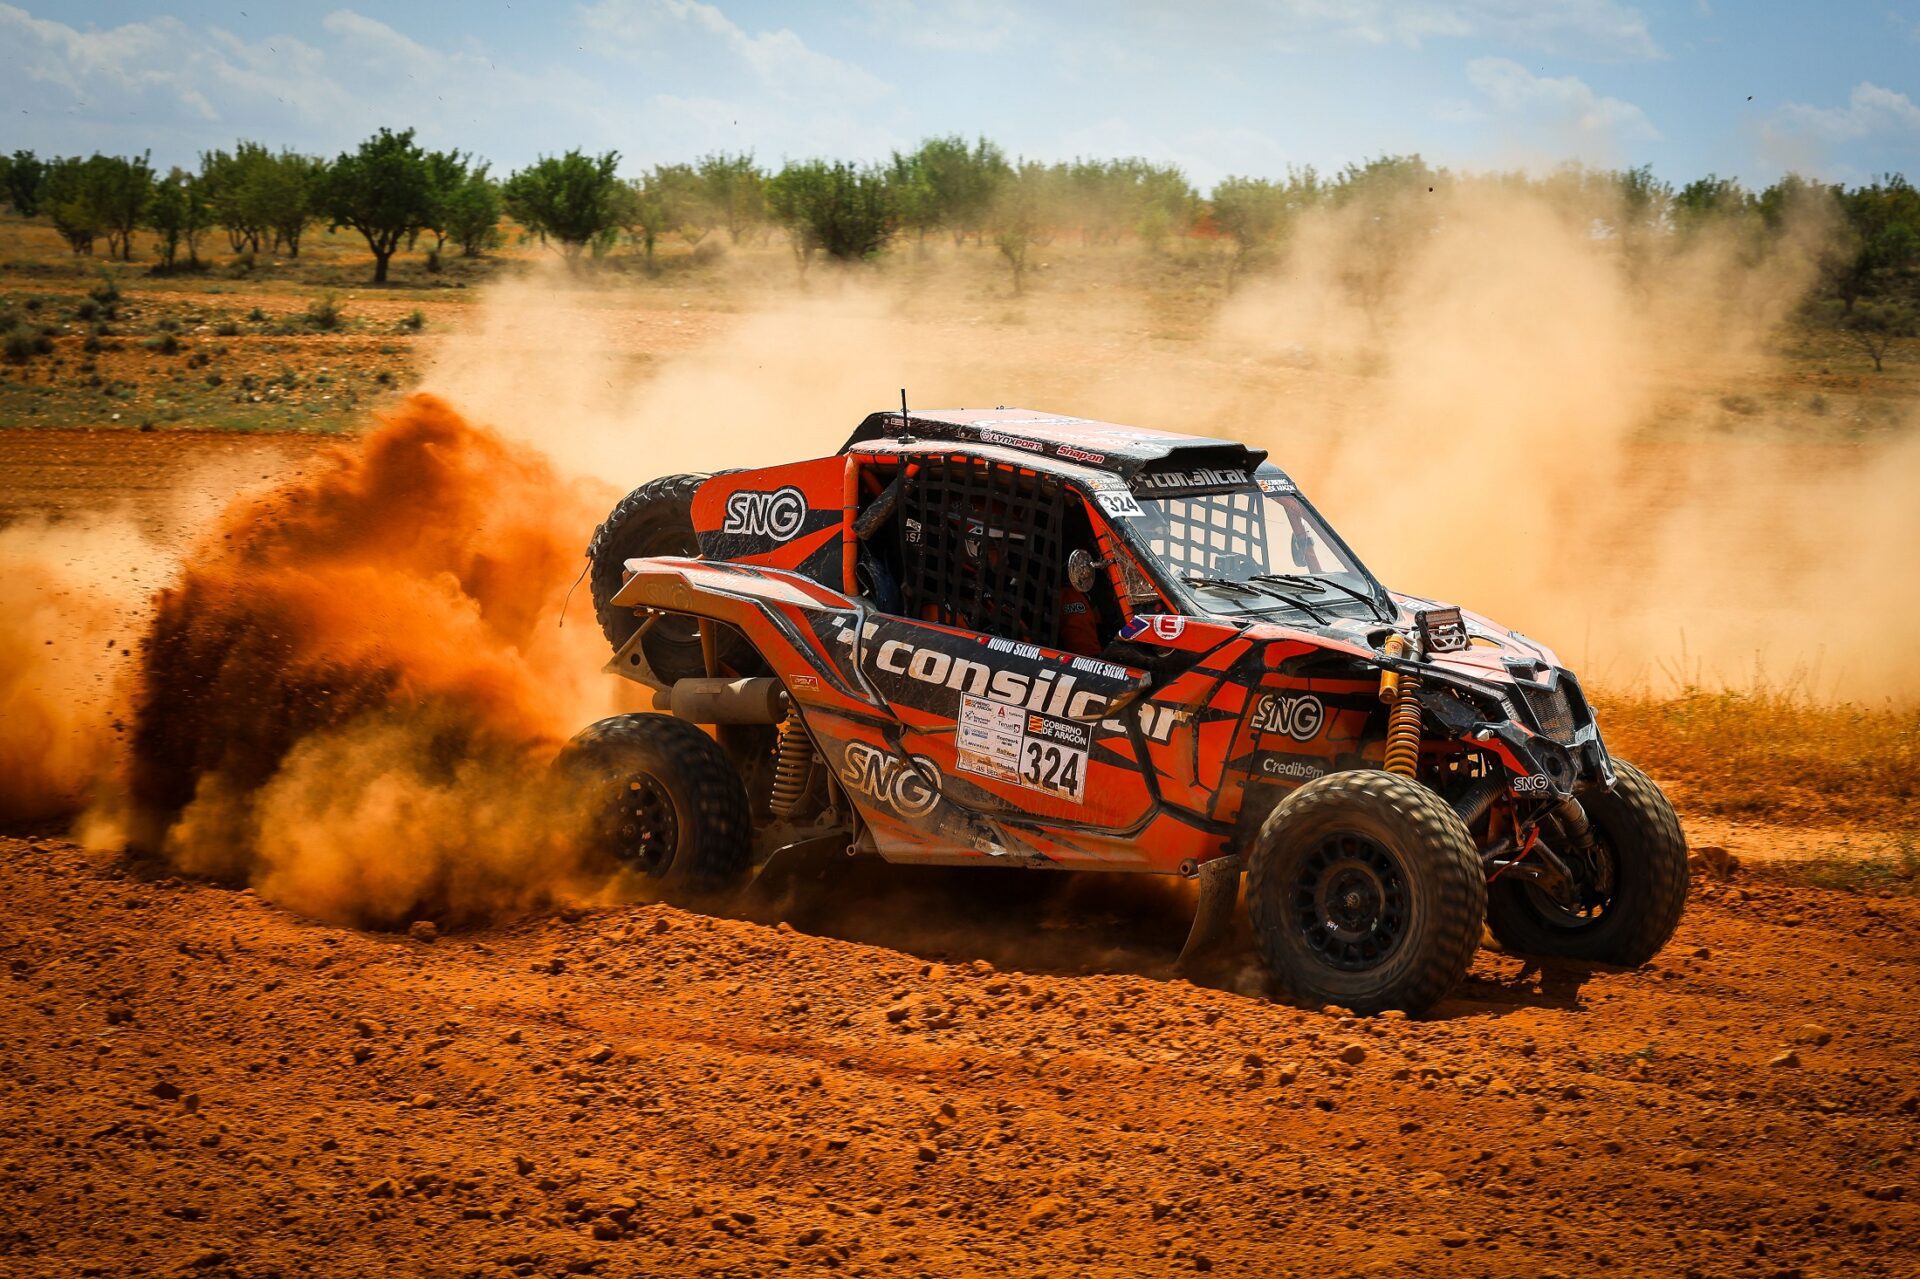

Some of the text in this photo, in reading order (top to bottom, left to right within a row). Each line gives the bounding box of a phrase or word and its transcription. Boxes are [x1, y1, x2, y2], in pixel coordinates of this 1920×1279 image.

[1058, 446, 1104, 463] Snap-on
[1104, 496, 1139, 512] 324
[724, 488, 806, 541] SNG
[1160, 616, 1177, 632] E
[987, 637, 1040, 660] NUNO SILVA
[1071, 656, 1125, 680] DUARTE SILVA
[1251, 694, 1324, 740] SNG
[1042, 727, 1087, 745] DE ARAGON
[1043, 719, 1082, 736] GOBIERNO
[1024, 742, 1079, 796] 324
[1263, 758, 1324, 778] Credibom
[841, 743, 942, 818] SNG
[1513, 773, 1549, 791] SNG
